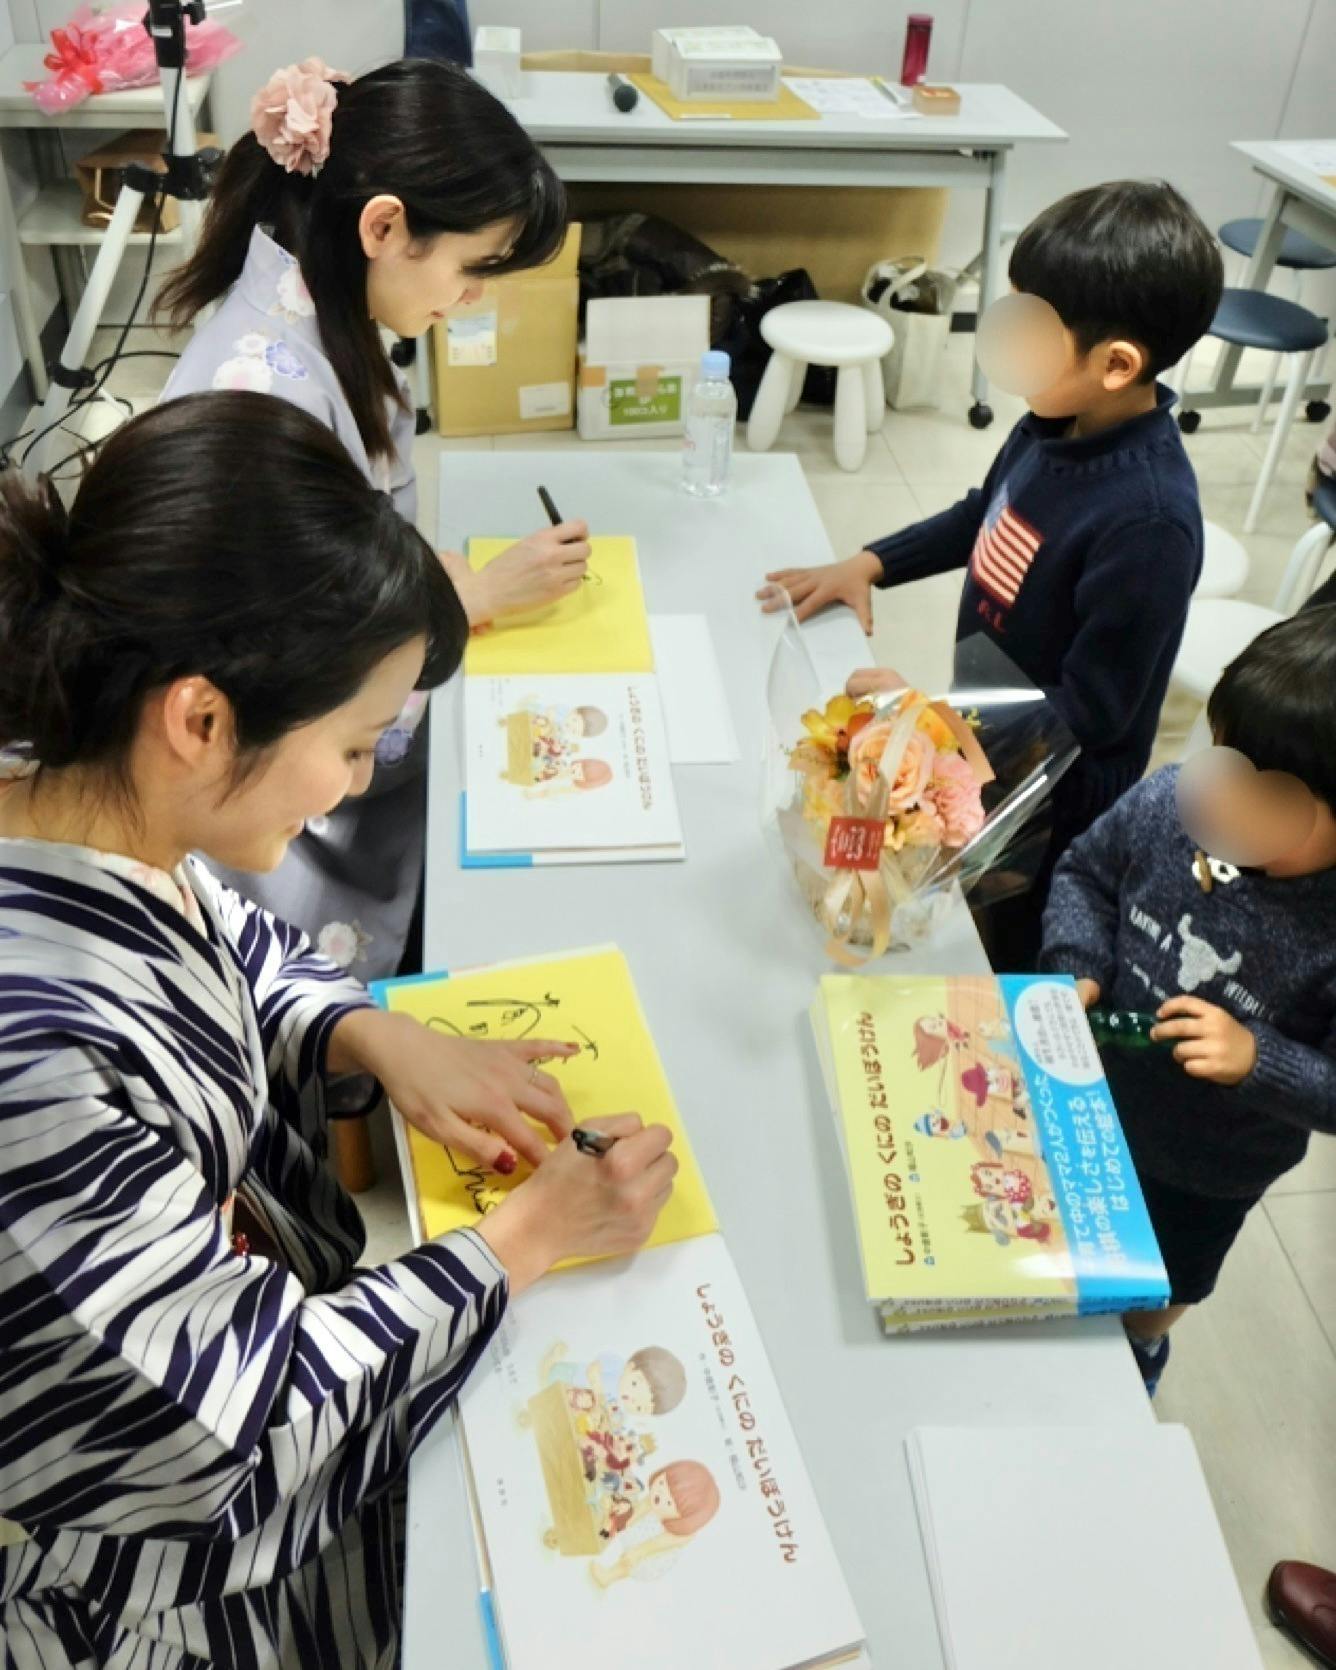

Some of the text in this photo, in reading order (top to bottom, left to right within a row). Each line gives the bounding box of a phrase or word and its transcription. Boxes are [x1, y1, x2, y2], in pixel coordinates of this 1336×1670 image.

[856, 1011, 917, 1266] しょうぎの くにの だいぼうけん
[696, 1282, 735, 1367] しょうぎの
[728, 1373, 756, 1431] くにの
[745, 1436, 798, 1563] だいぼうけん
